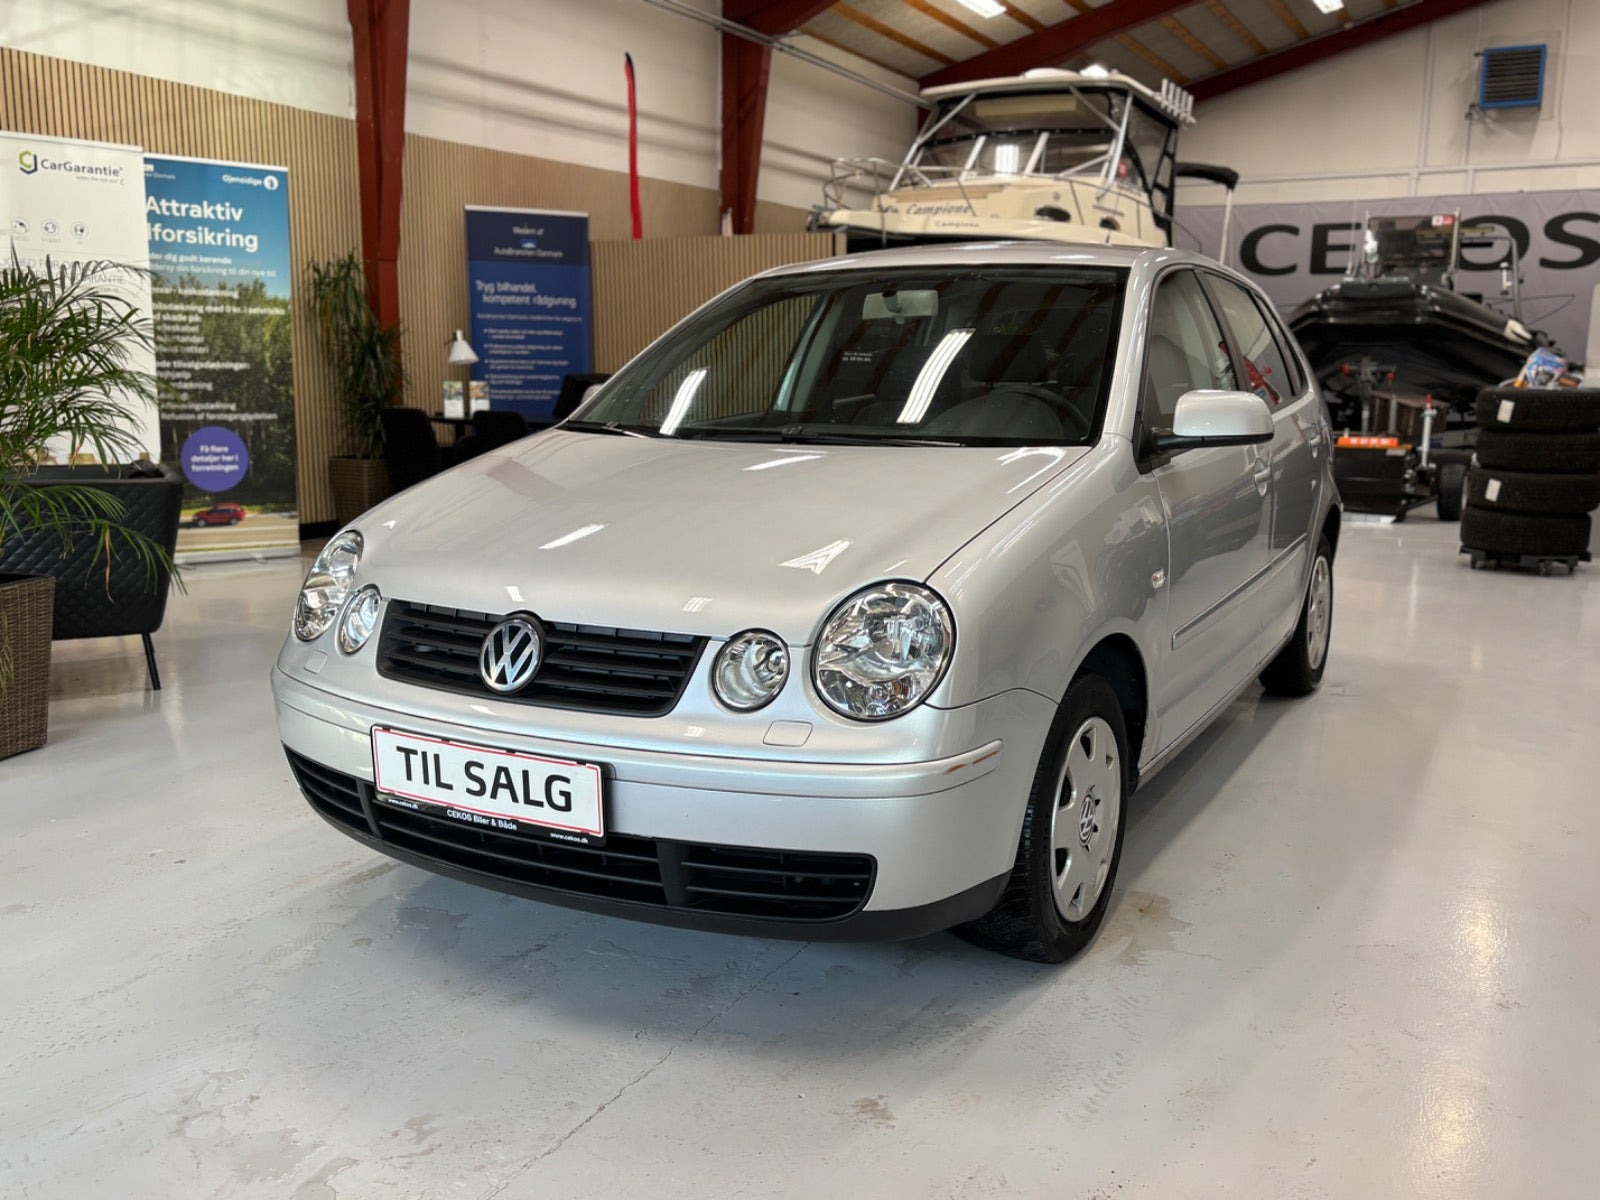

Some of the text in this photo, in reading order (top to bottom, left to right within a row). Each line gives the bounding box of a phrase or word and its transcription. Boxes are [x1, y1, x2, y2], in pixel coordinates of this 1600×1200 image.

[41, 159, 121, 177] CarGarantie
[222, 174, 262, 186] Gjensidige
[147, 195, 243, 221] Attraktiv
[1240, 211, 1600, 279] CEOS
[476, 280, 495, 294] Tryg
[396, 745, 572, 812] TIL SALG
[446, 809, 518, 831] CEKOS Biler & Både
[550, 832, 589, 844] www.cekos.dk
